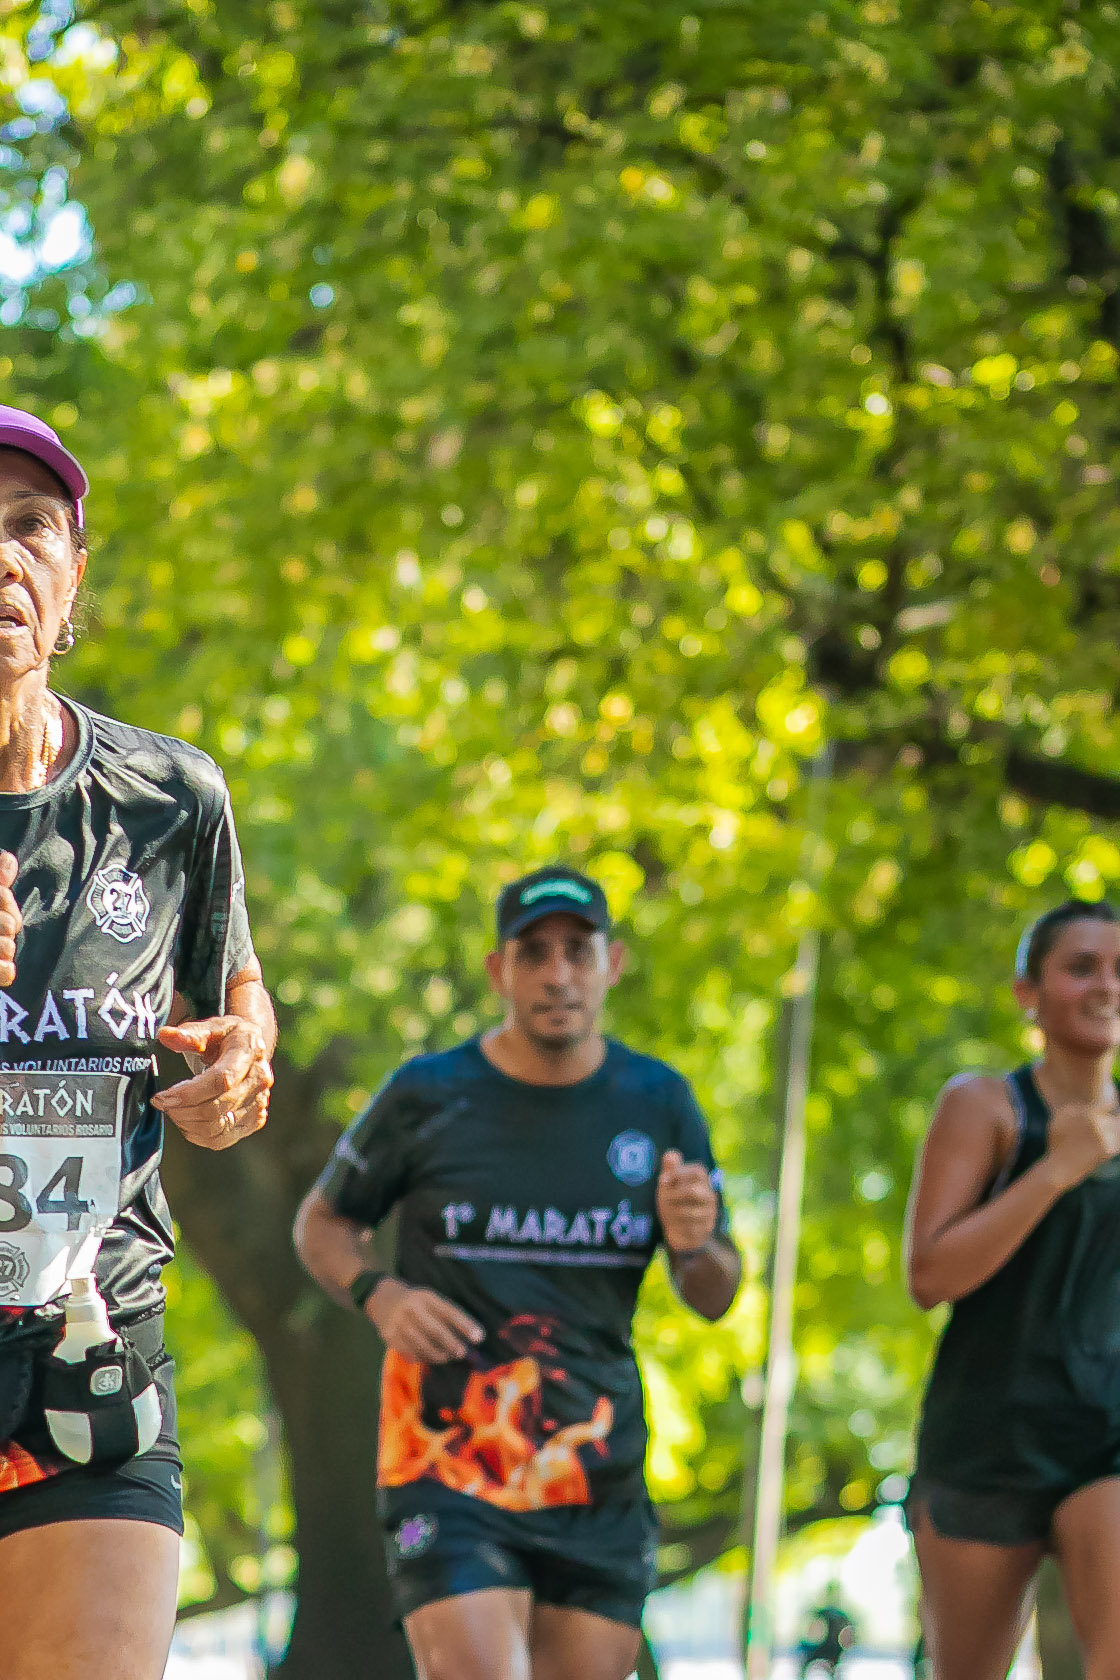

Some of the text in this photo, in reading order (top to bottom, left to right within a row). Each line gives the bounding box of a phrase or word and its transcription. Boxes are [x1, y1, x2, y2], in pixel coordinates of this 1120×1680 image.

[9, 1123, 75, 1136] VOLUNTARIOS
[75, 1124, 114, 1136] ROSARIO
[484, 1199, 654, 1248] MARATÓN
